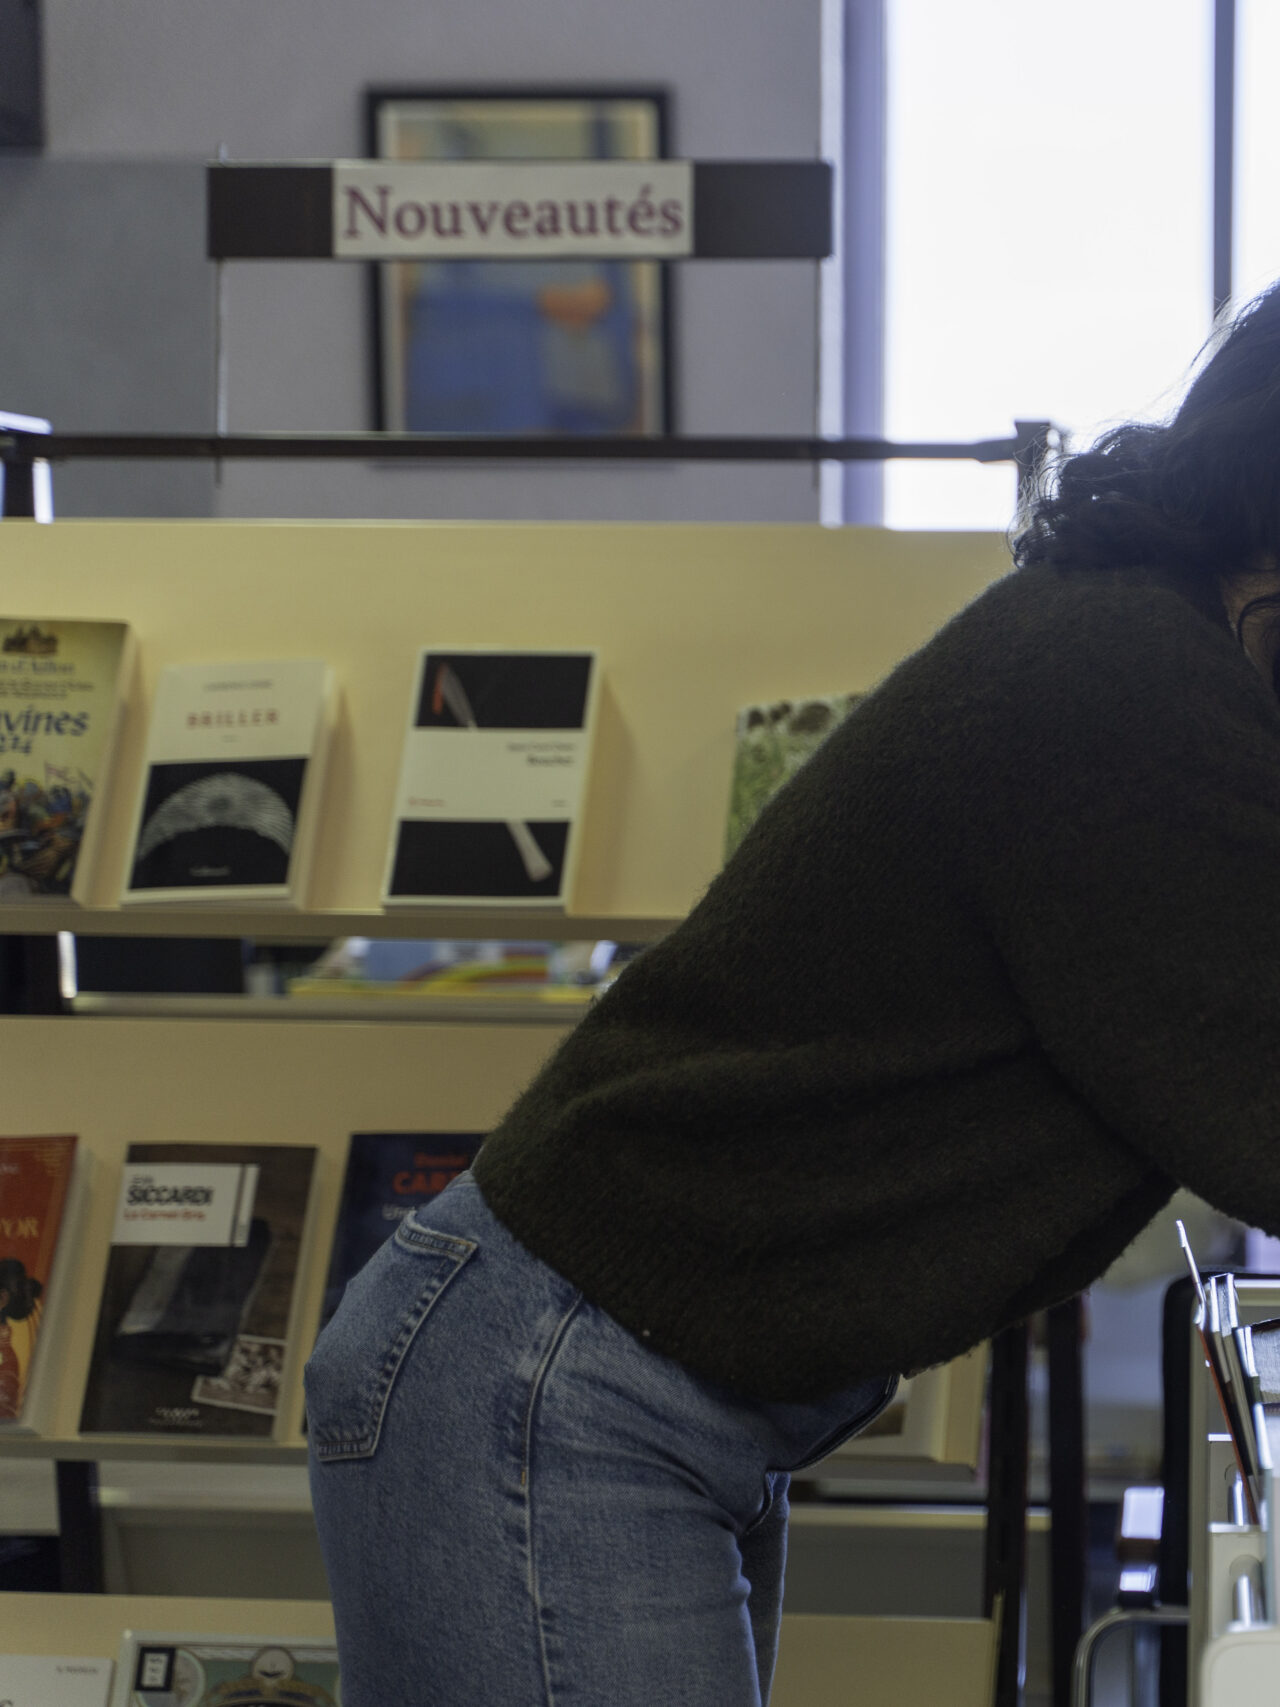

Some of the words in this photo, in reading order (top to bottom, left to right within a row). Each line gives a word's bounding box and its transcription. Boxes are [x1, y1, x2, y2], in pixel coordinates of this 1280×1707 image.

[343, 183, 684, 239] Nouveautés
[185, 708, 280, 730] BRILLER
[126, 1185, 215, 1206] SICCARDI
